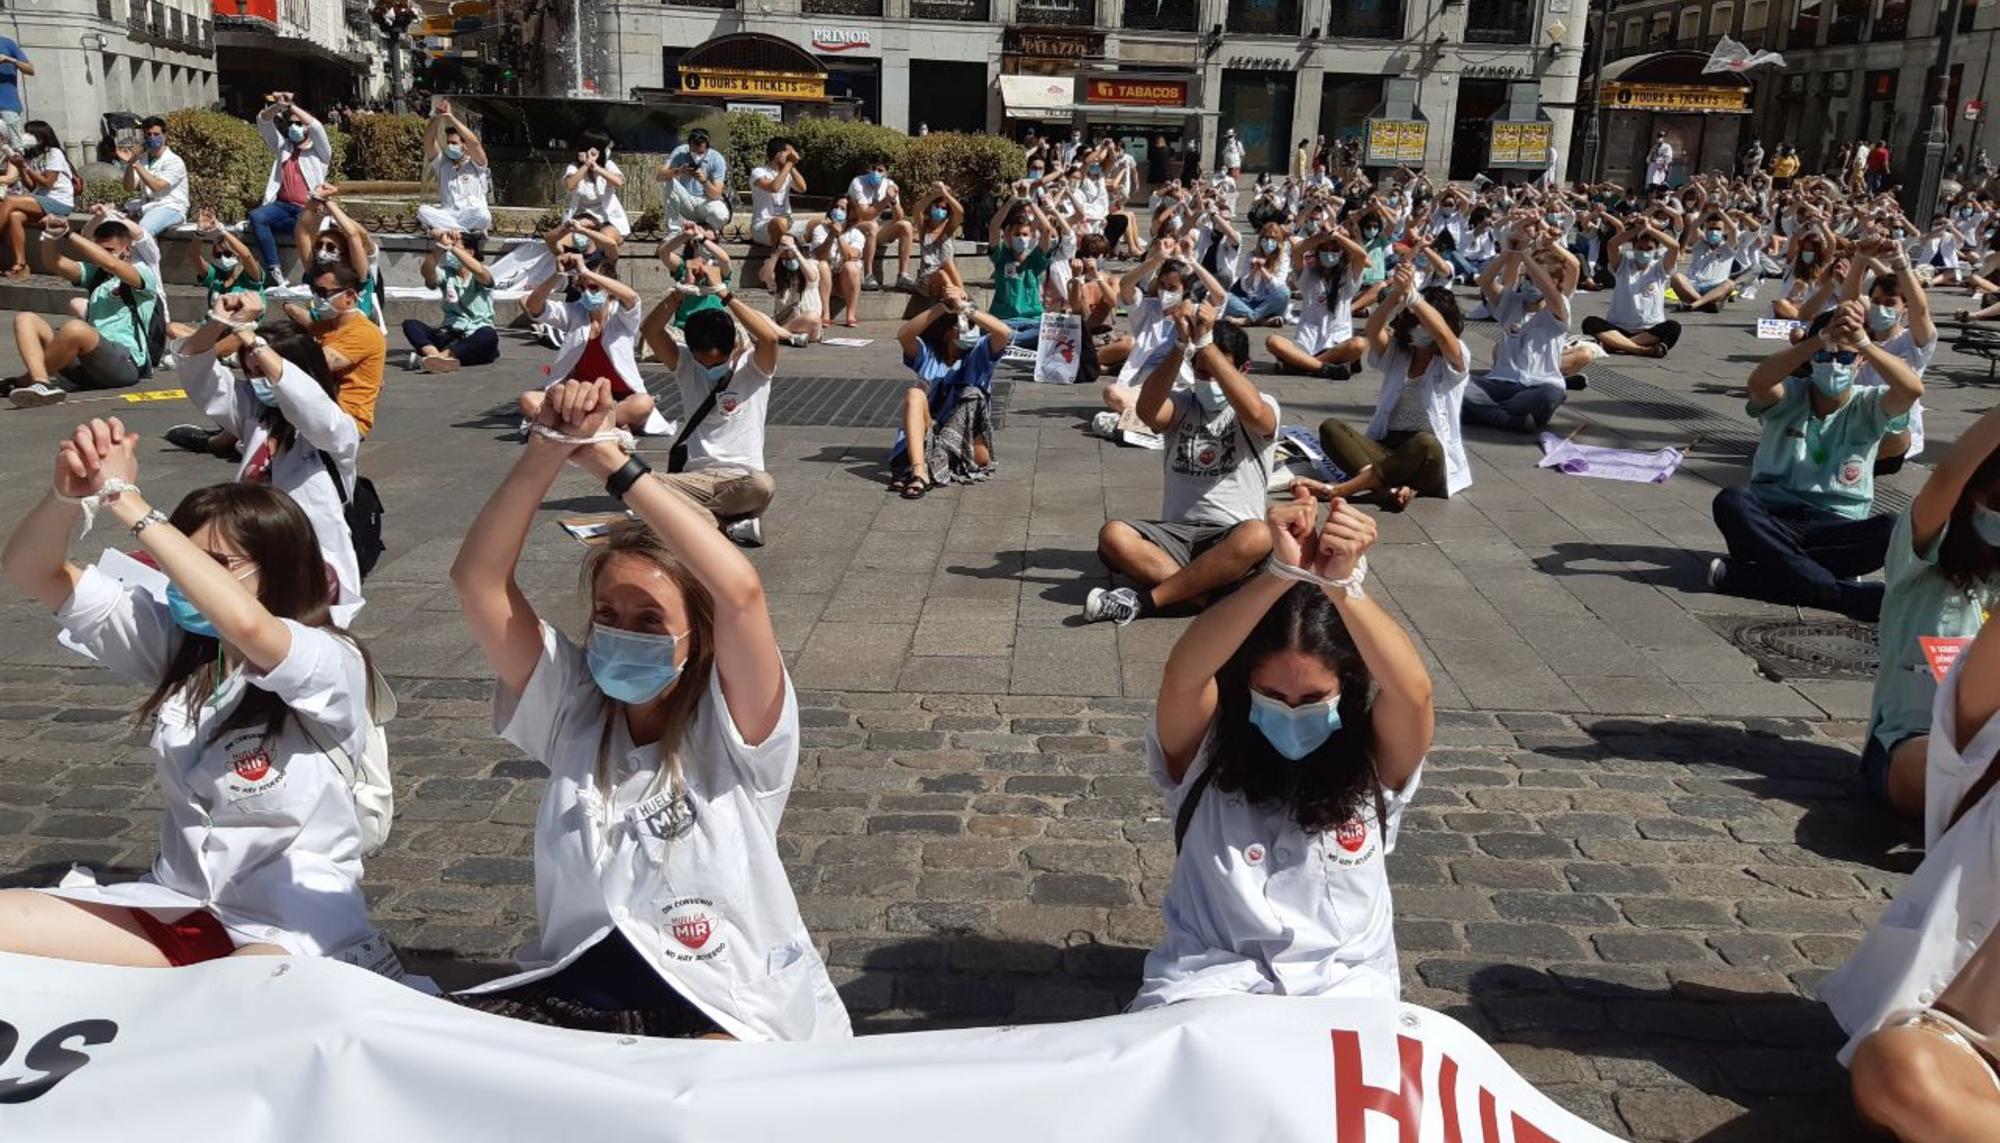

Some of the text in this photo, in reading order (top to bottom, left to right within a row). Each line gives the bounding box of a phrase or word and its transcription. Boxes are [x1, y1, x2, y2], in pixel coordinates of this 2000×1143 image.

[812, 29, 871, 44] PRIMOR
[703, 77, 737, 90] TOURS
[741, 78, 749, 90] &
[753, 79, 798, 92] TICKETS
[1118, 86, 1179, 98] TABACOS
[1634, 92, 1665, 104] TOURS
[1679, 94, 1720, 106] TICKETS
[671, 912, 707, 925] HUELGA
[675, 922, 708, 938] MIR
[664, 948, 676, 958] NO
[676, 953, 693, 962] HAY
